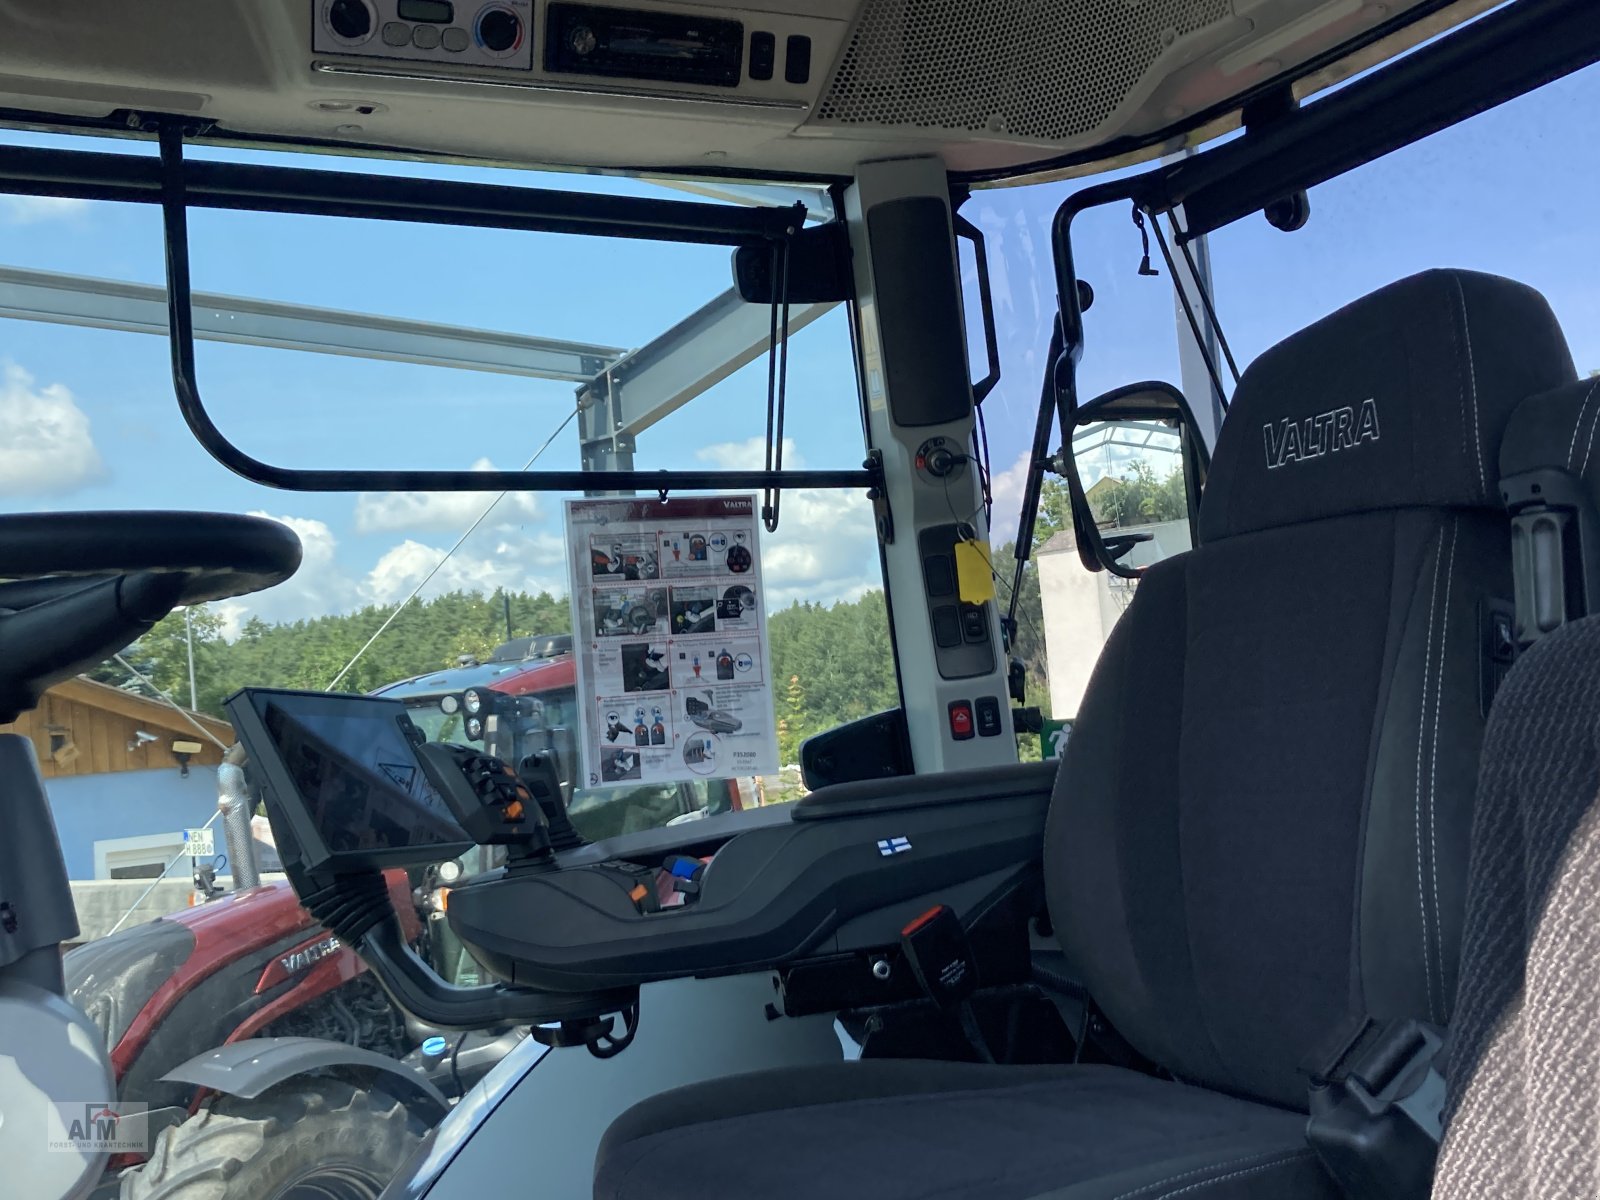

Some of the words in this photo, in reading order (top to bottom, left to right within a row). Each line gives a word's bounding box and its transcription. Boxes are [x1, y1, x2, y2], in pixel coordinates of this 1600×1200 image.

[1263, 398, 1380, 469] VALTRA
[723, 500, 752, 508] VALTRA
[281, 937, 340, 973] VALTRA
